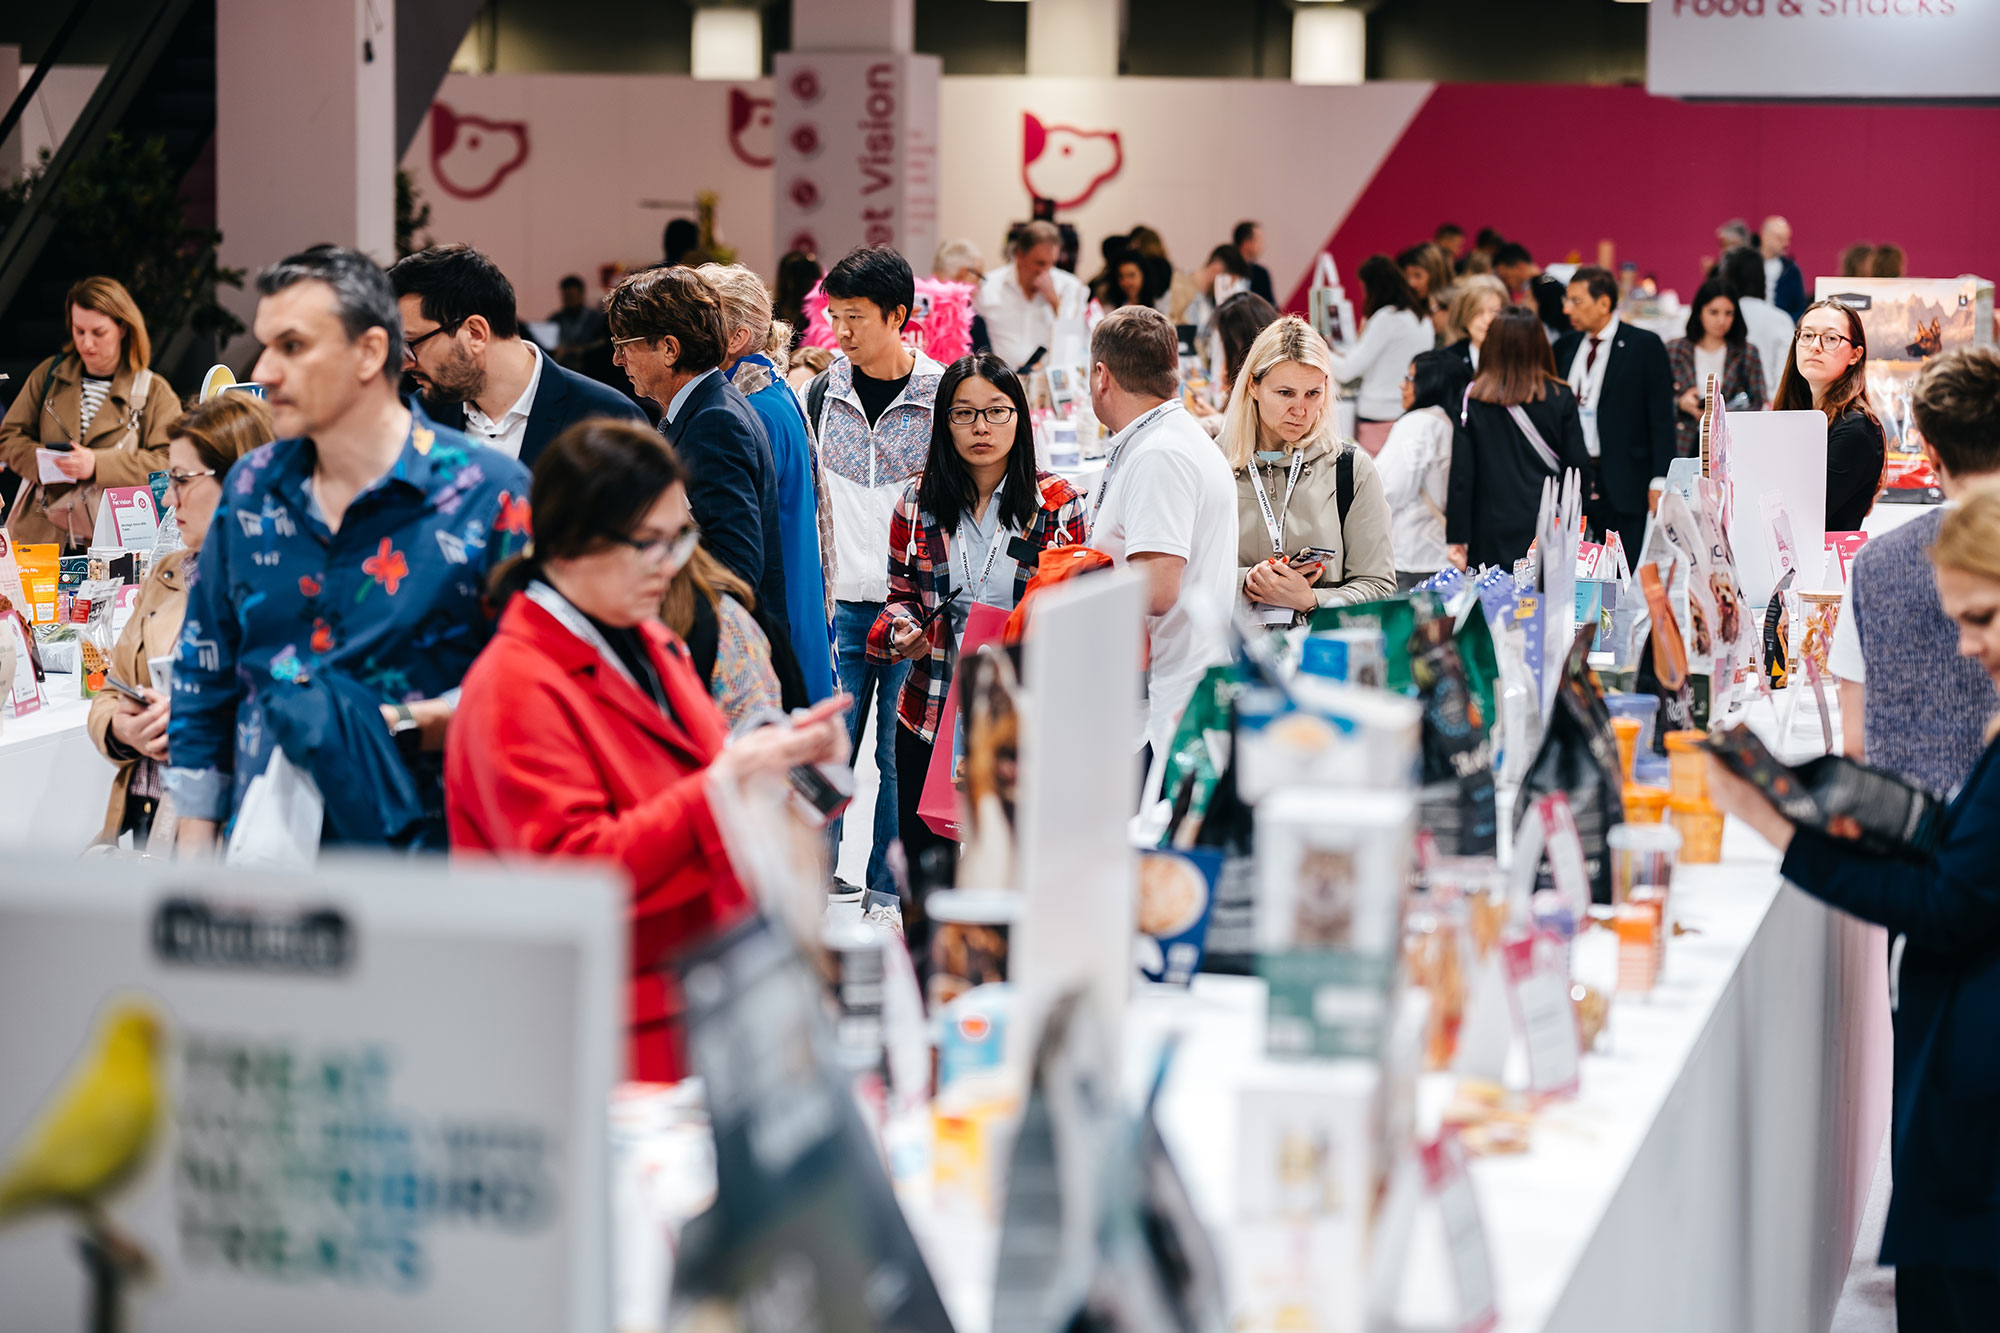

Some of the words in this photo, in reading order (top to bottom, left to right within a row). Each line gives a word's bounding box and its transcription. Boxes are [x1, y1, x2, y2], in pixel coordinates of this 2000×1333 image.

[857, 63, 895, 196] Vision
[1290, 454, 1301, 484] ZOOMARK
[1097, 481, 1107, 504] ZOOMARK
[1260, 490, 1273, 518] ZOOMARK
[984, 546, 998, 576] ZOOMARK
